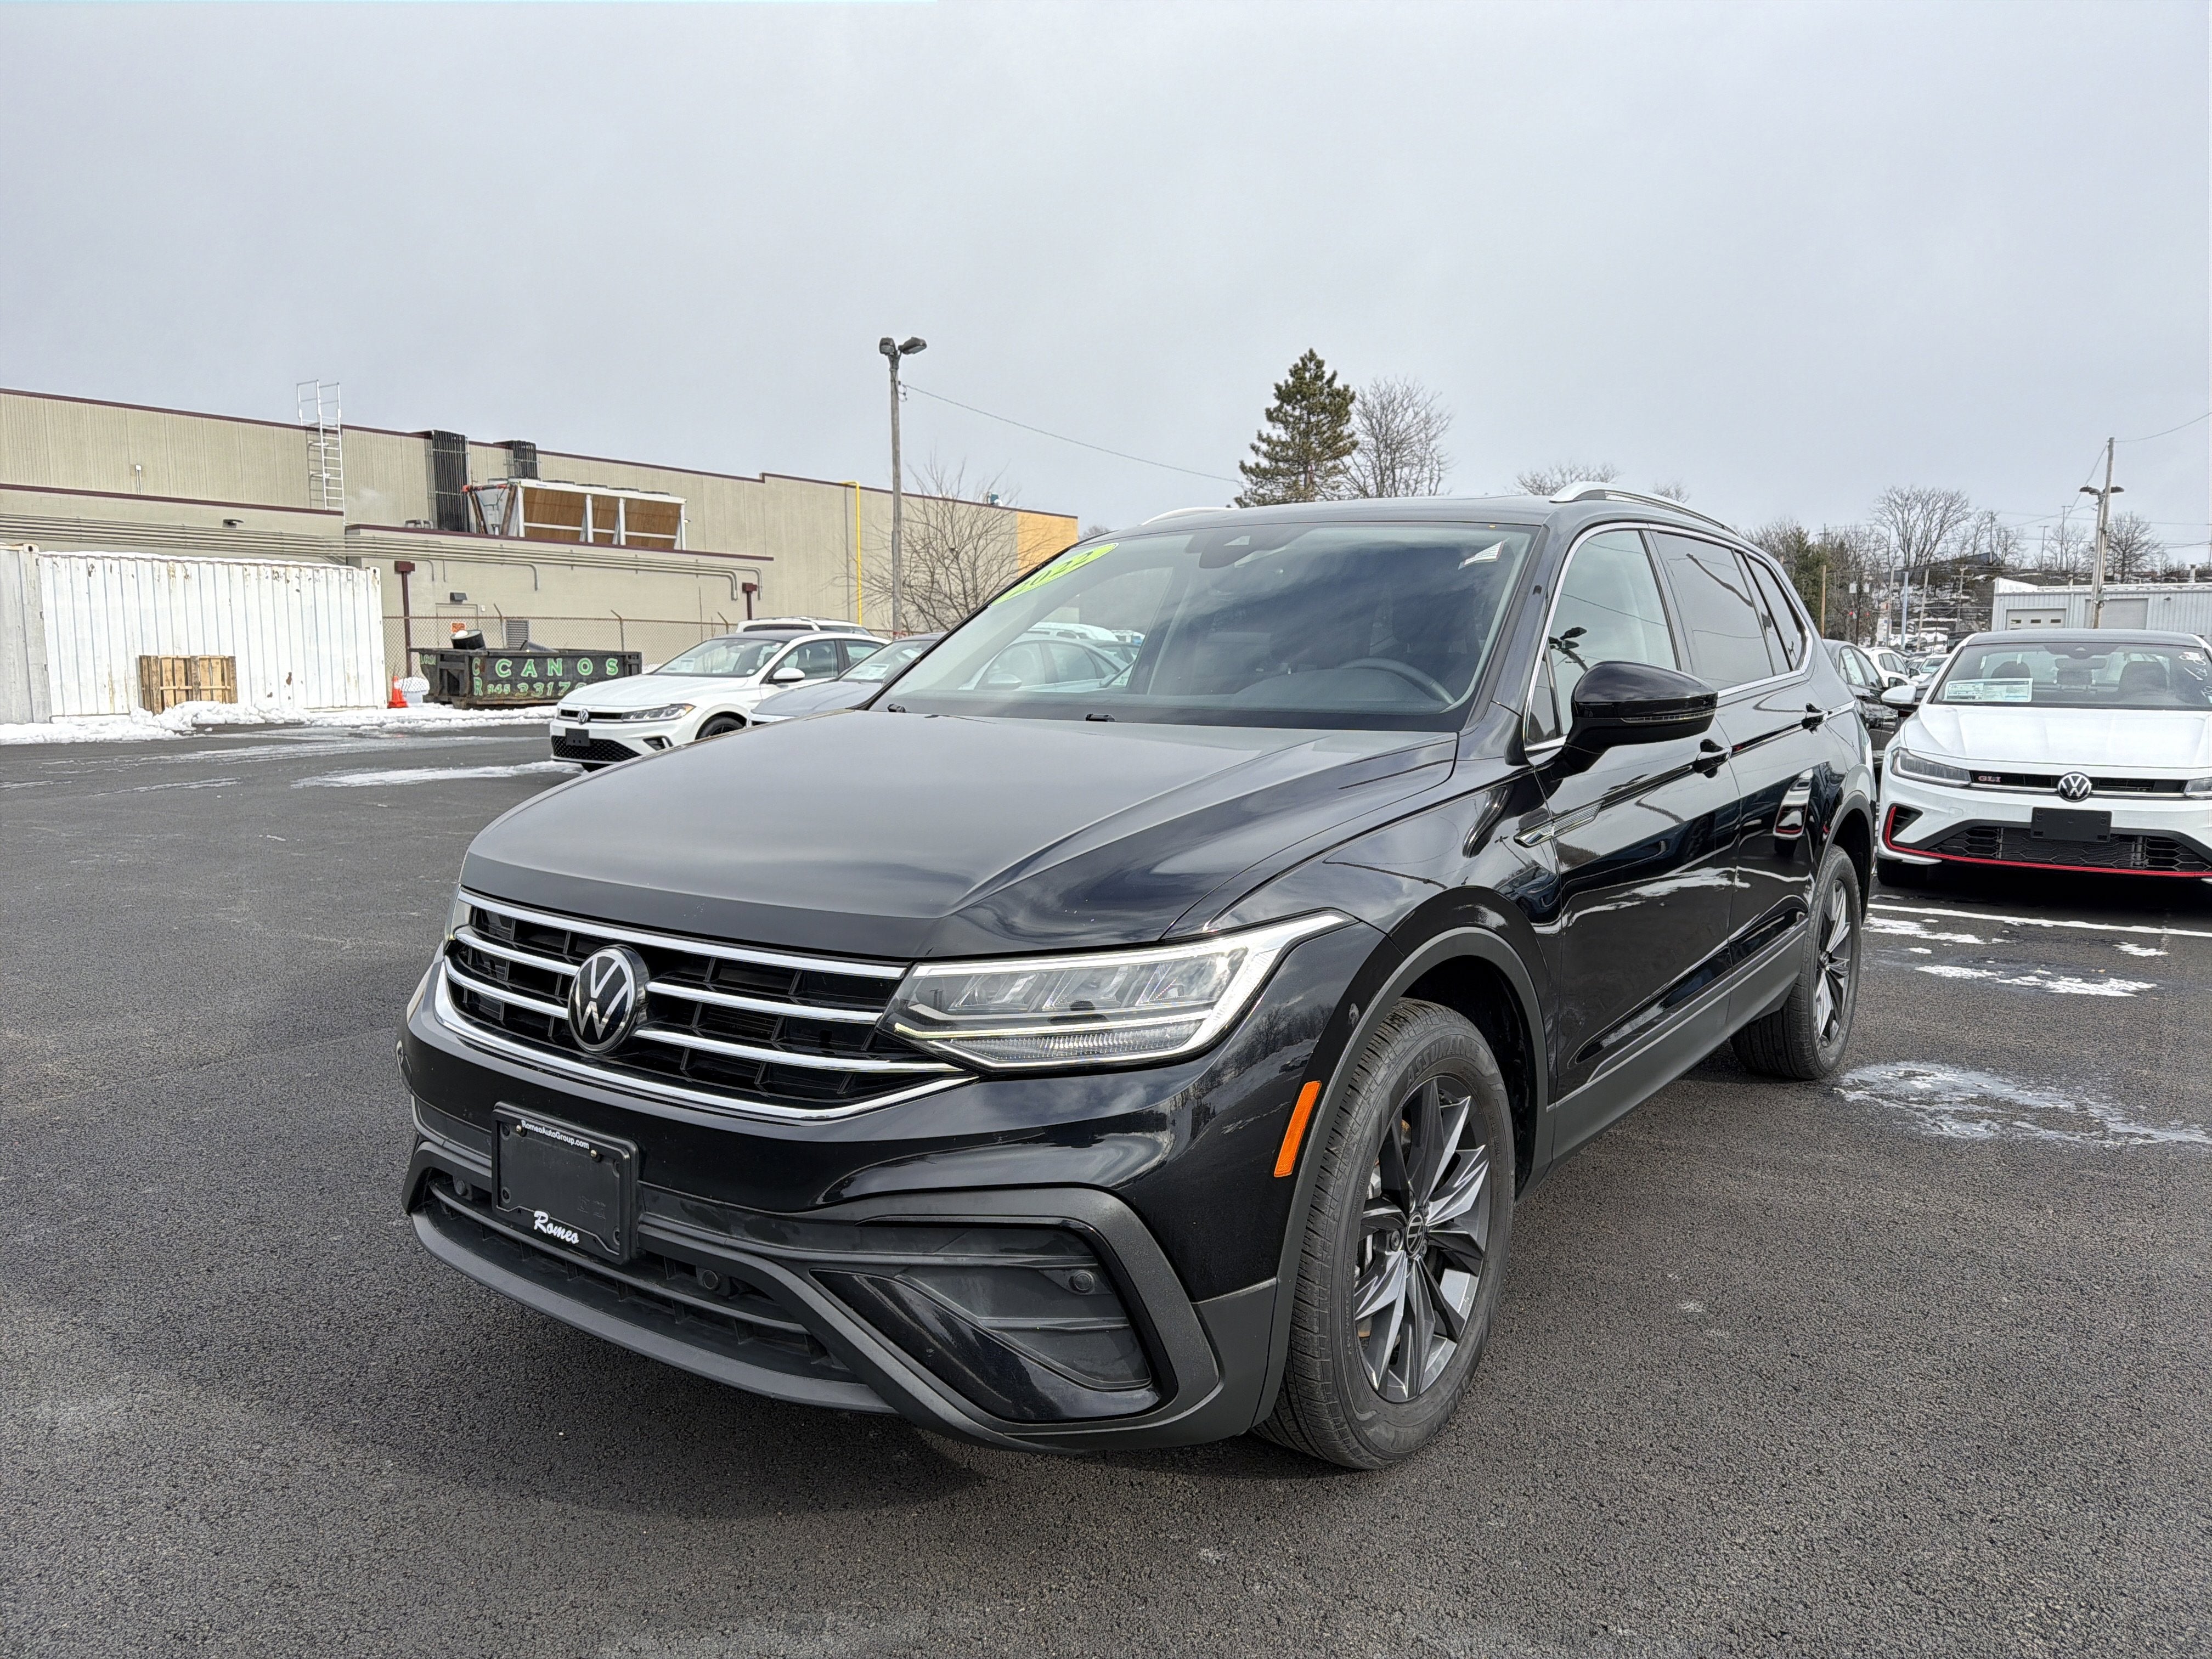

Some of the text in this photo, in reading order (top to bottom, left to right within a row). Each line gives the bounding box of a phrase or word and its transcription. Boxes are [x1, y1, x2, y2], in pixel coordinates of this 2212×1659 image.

[495, 658, 619, 678] CANOS
[515, 681, 588, 698] 3317
[2058, 772, 2091, 800] VW
[572, 951, 634, 1047] VW
[521, 1120, 590, 1149] RomeoAutoGroup.com
[534, 1210, 579, 1244] Romeo
